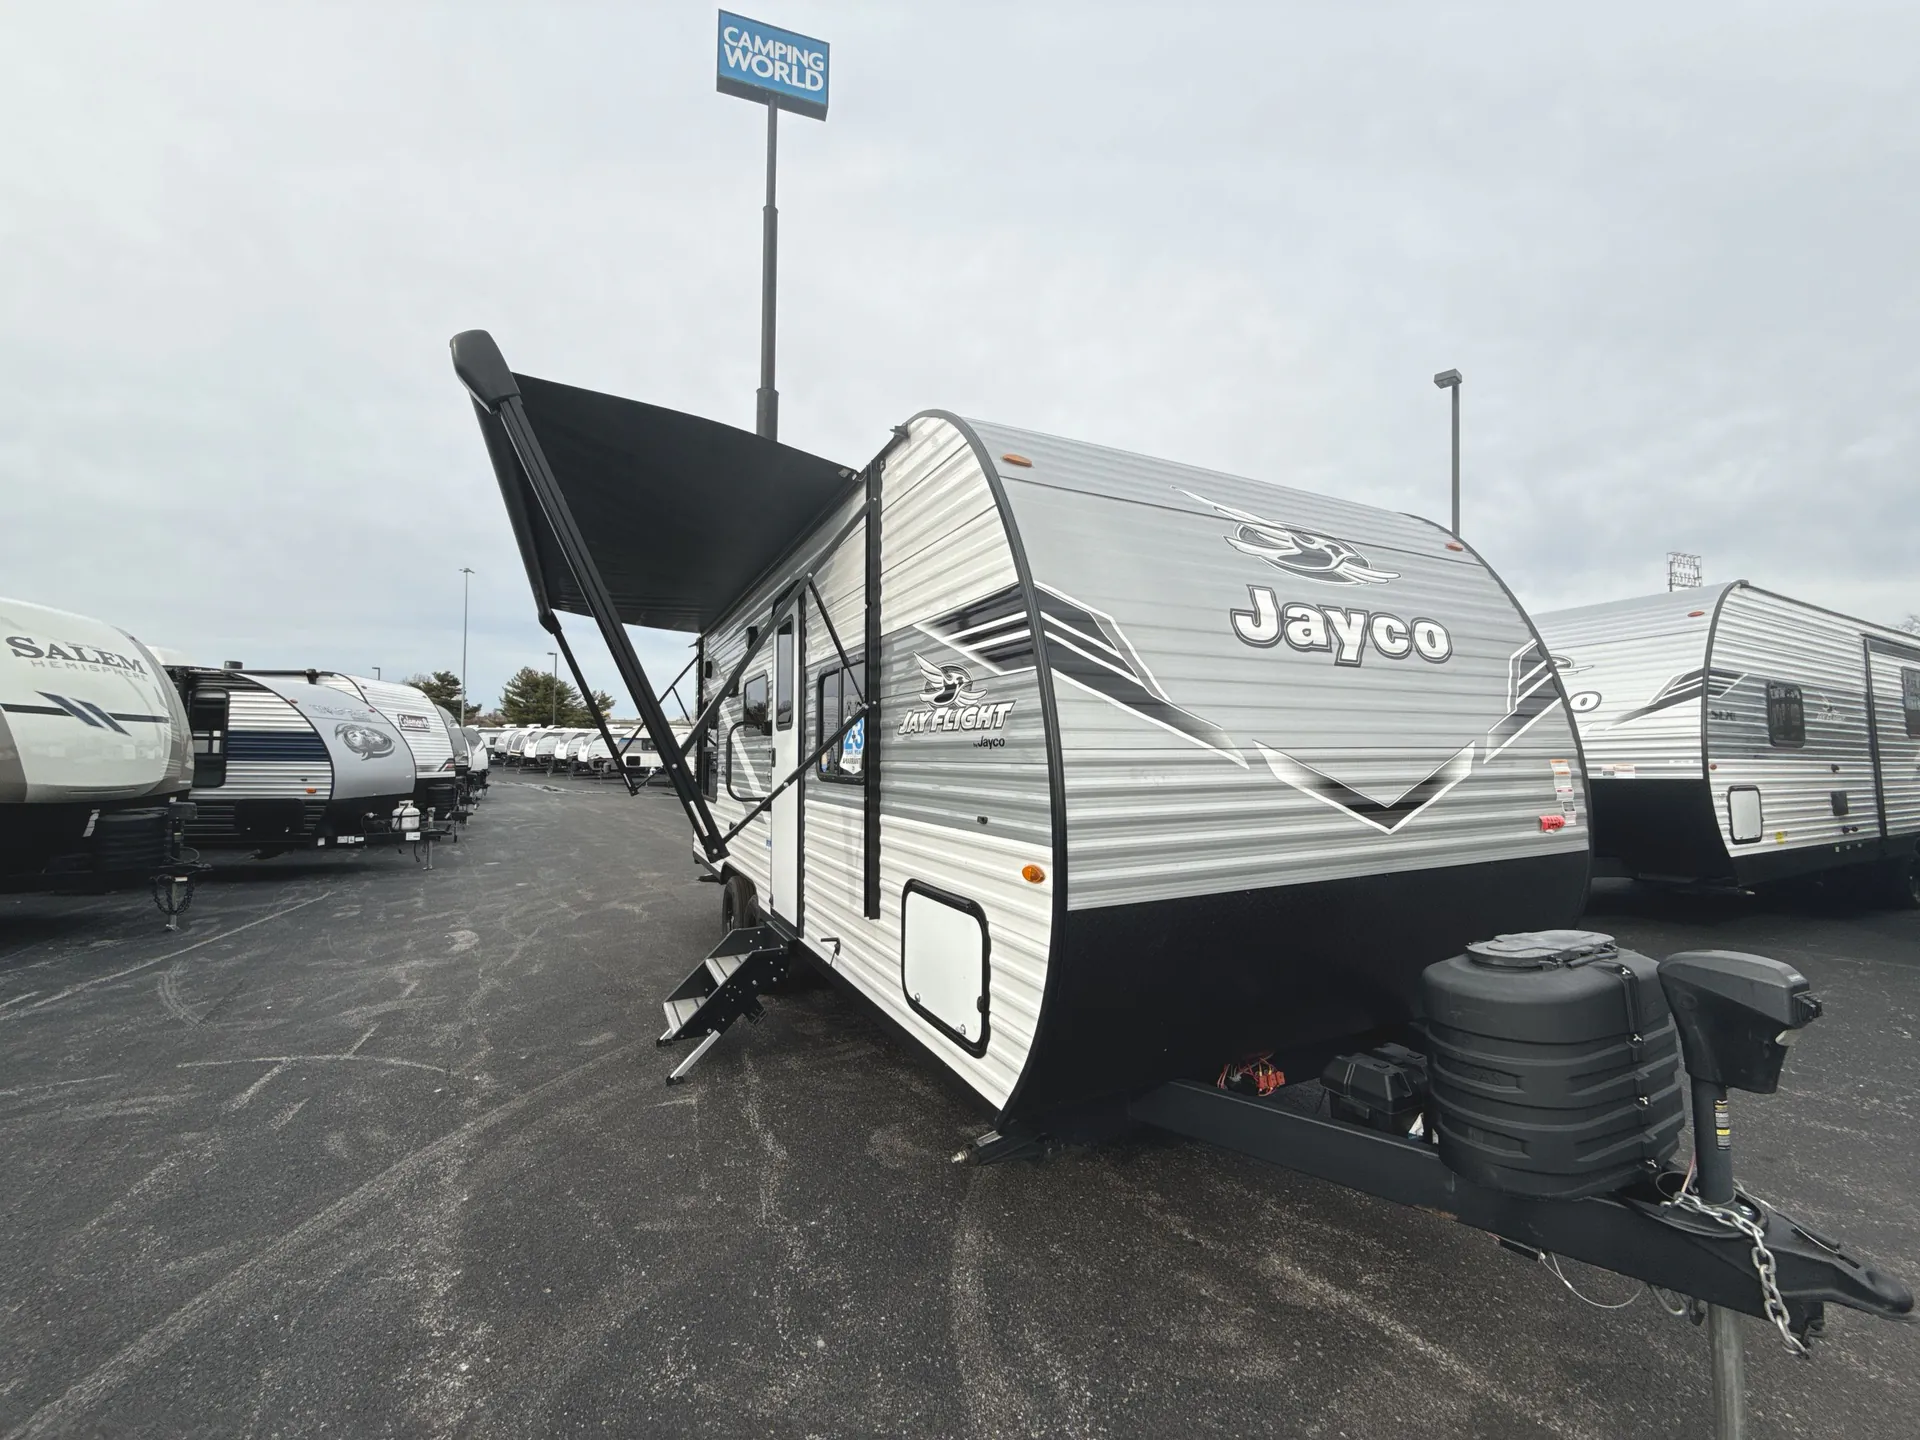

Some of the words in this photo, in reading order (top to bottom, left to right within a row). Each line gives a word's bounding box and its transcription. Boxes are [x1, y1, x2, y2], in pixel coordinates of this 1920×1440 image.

[723, 26, 824, 72] CAMPING
[723, 43, 824, 92] WORLD
[1229, 583, 1453, 668] Jayco
[5, 636, 148, 675] SALEM
[30, 659, 149, 682] HEMISPHERE
[898, 710, 933, 735] JAY
[929, 699, 1018, 733] FLIGHT
[978, 736, 1006, 750] Jayco
